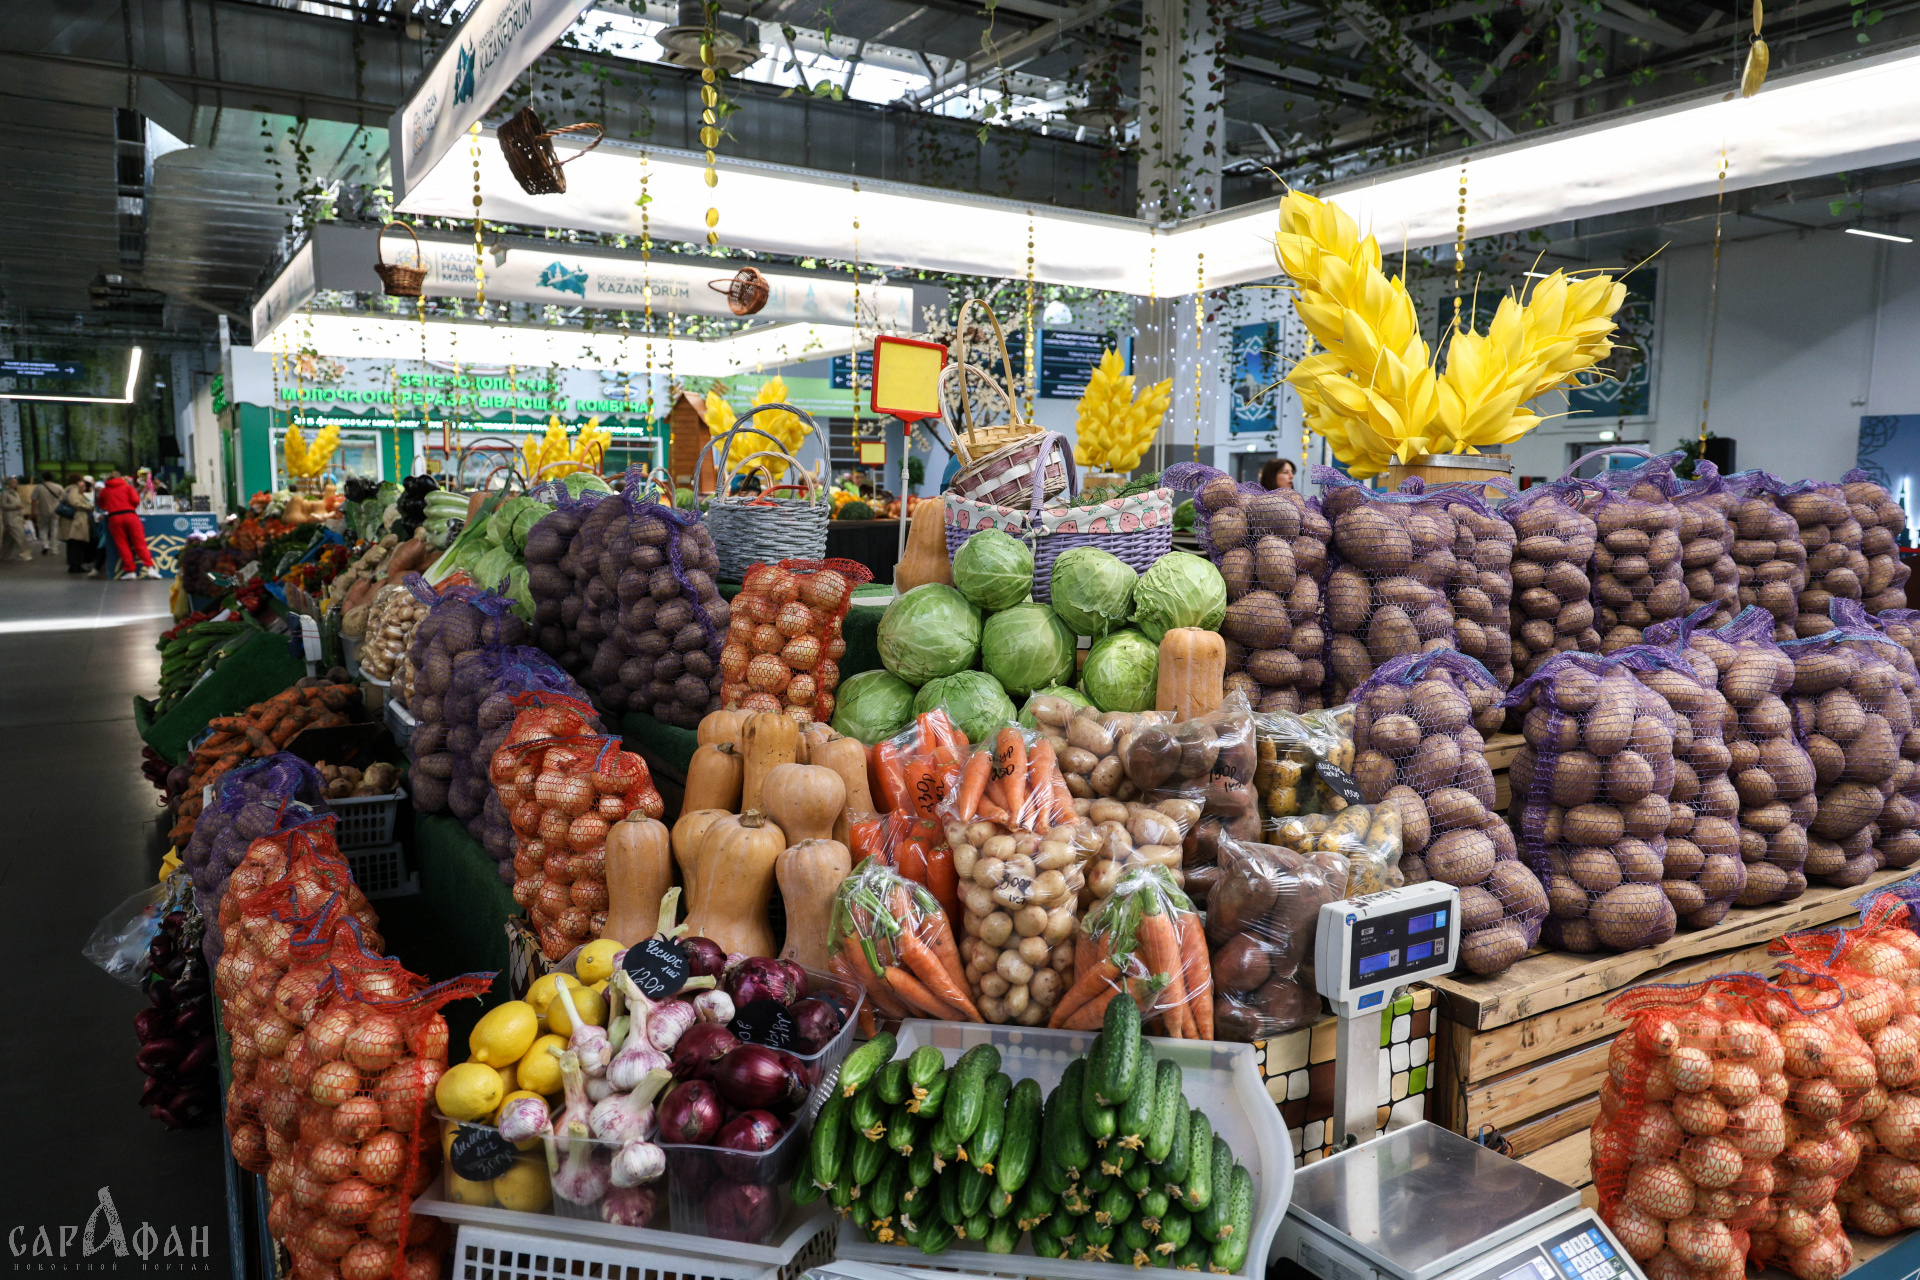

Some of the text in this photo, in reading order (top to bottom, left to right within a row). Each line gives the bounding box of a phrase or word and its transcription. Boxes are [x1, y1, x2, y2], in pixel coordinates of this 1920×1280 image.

[479, 0, 532, 78] KAZANFORUM
[441, 272, 490, 285] MARKT
[597, 282, 689, 299] KAZANORUM
[645, 939, 684, 969] Чеснок
[629, 966, 666, 995] 120р
[1361, 993, 1381, 1007] CAS
